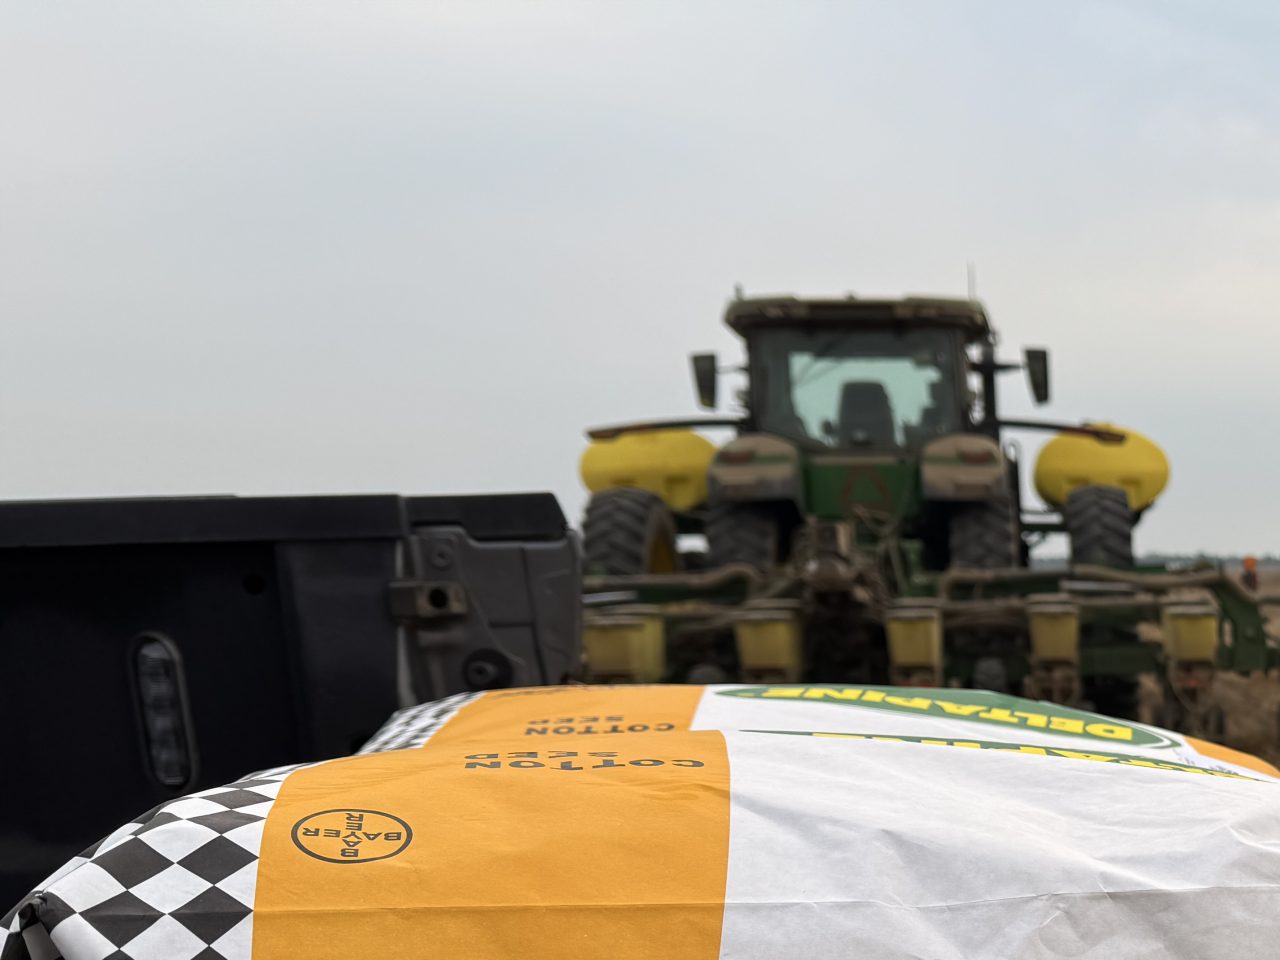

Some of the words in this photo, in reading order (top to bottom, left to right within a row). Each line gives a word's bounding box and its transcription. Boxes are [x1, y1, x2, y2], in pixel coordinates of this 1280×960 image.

[525, 722, 676, 735] COTTON
[464, 758, 705, 770] COTTON
[302, 827, 402, 842] BAYER
[340, 812, 364, 858] BAYER
